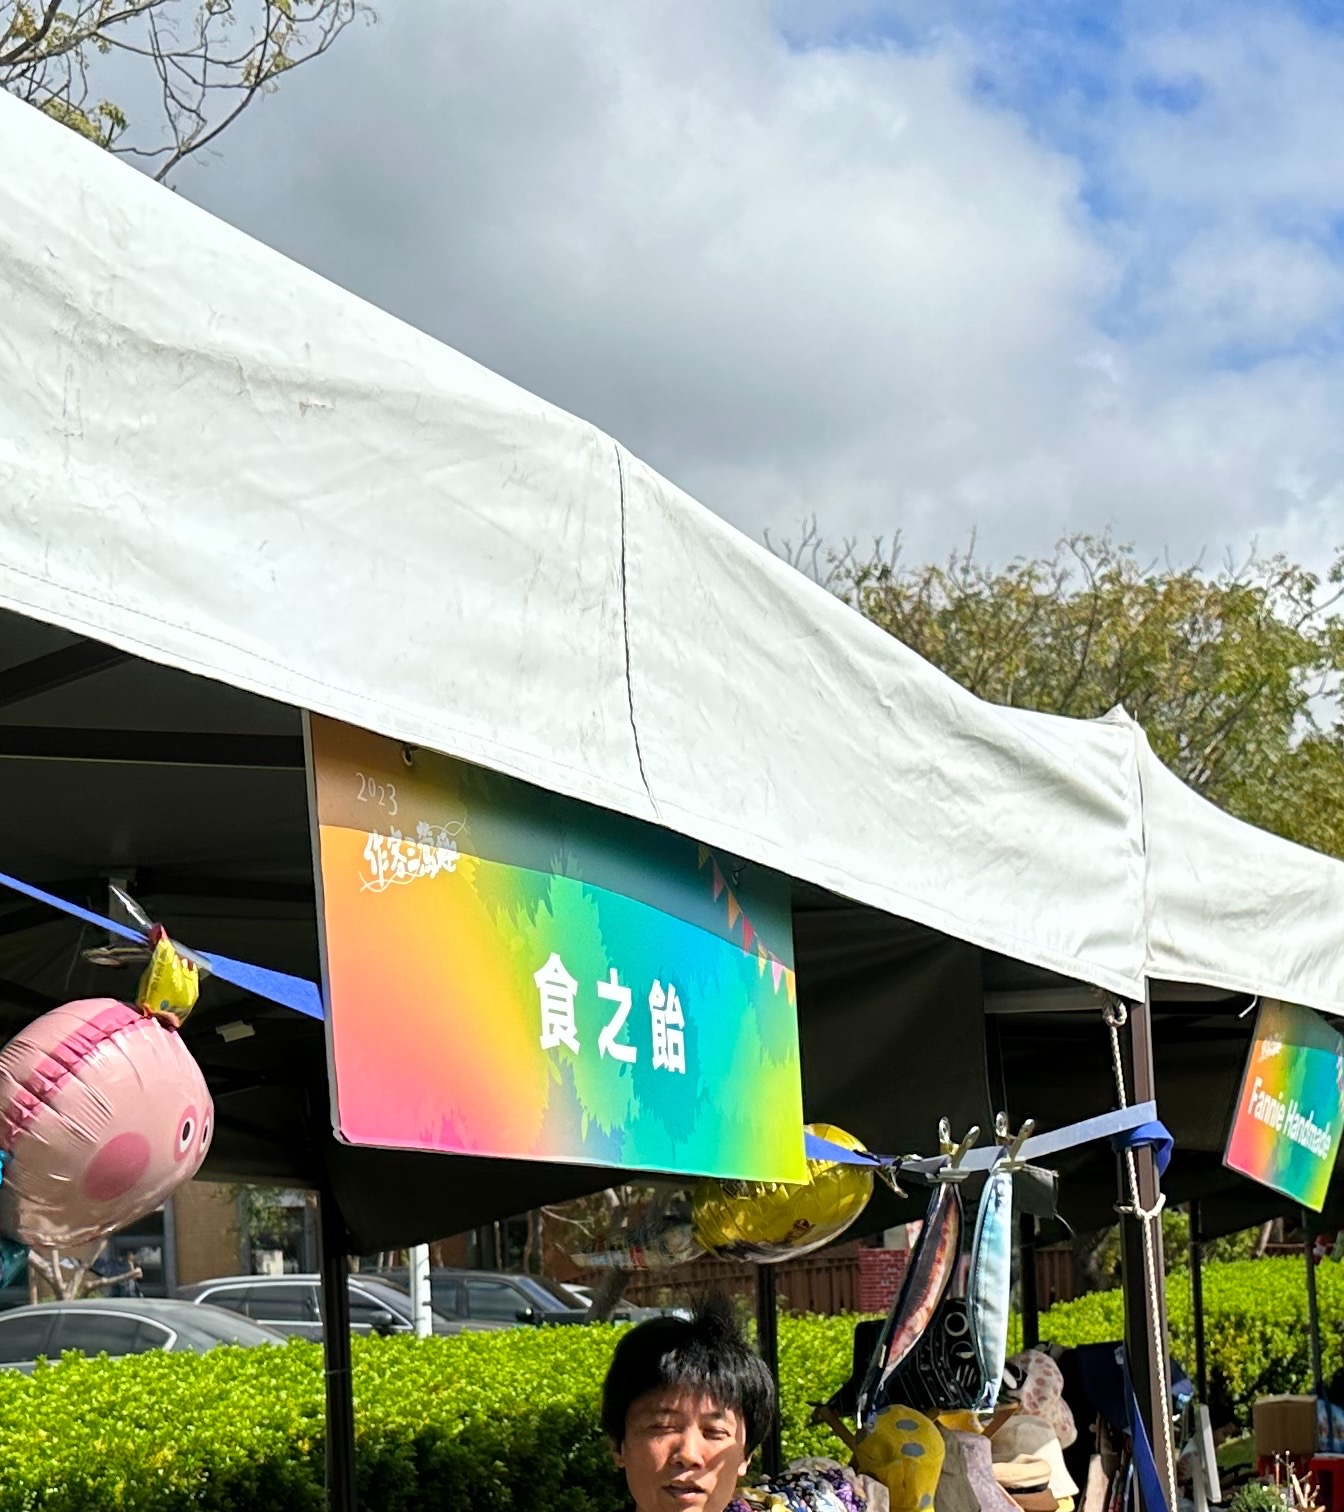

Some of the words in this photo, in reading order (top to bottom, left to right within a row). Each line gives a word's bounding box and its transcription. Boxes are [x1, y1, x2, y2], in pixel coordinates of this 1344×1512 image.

[356, 772, 398, 816] 2023
[532, 951, 686, 1075] 食之飴
[1247, 1076, 1286, 1132] Fannie
[1282, 1098, 1332, 1161] Handmade
